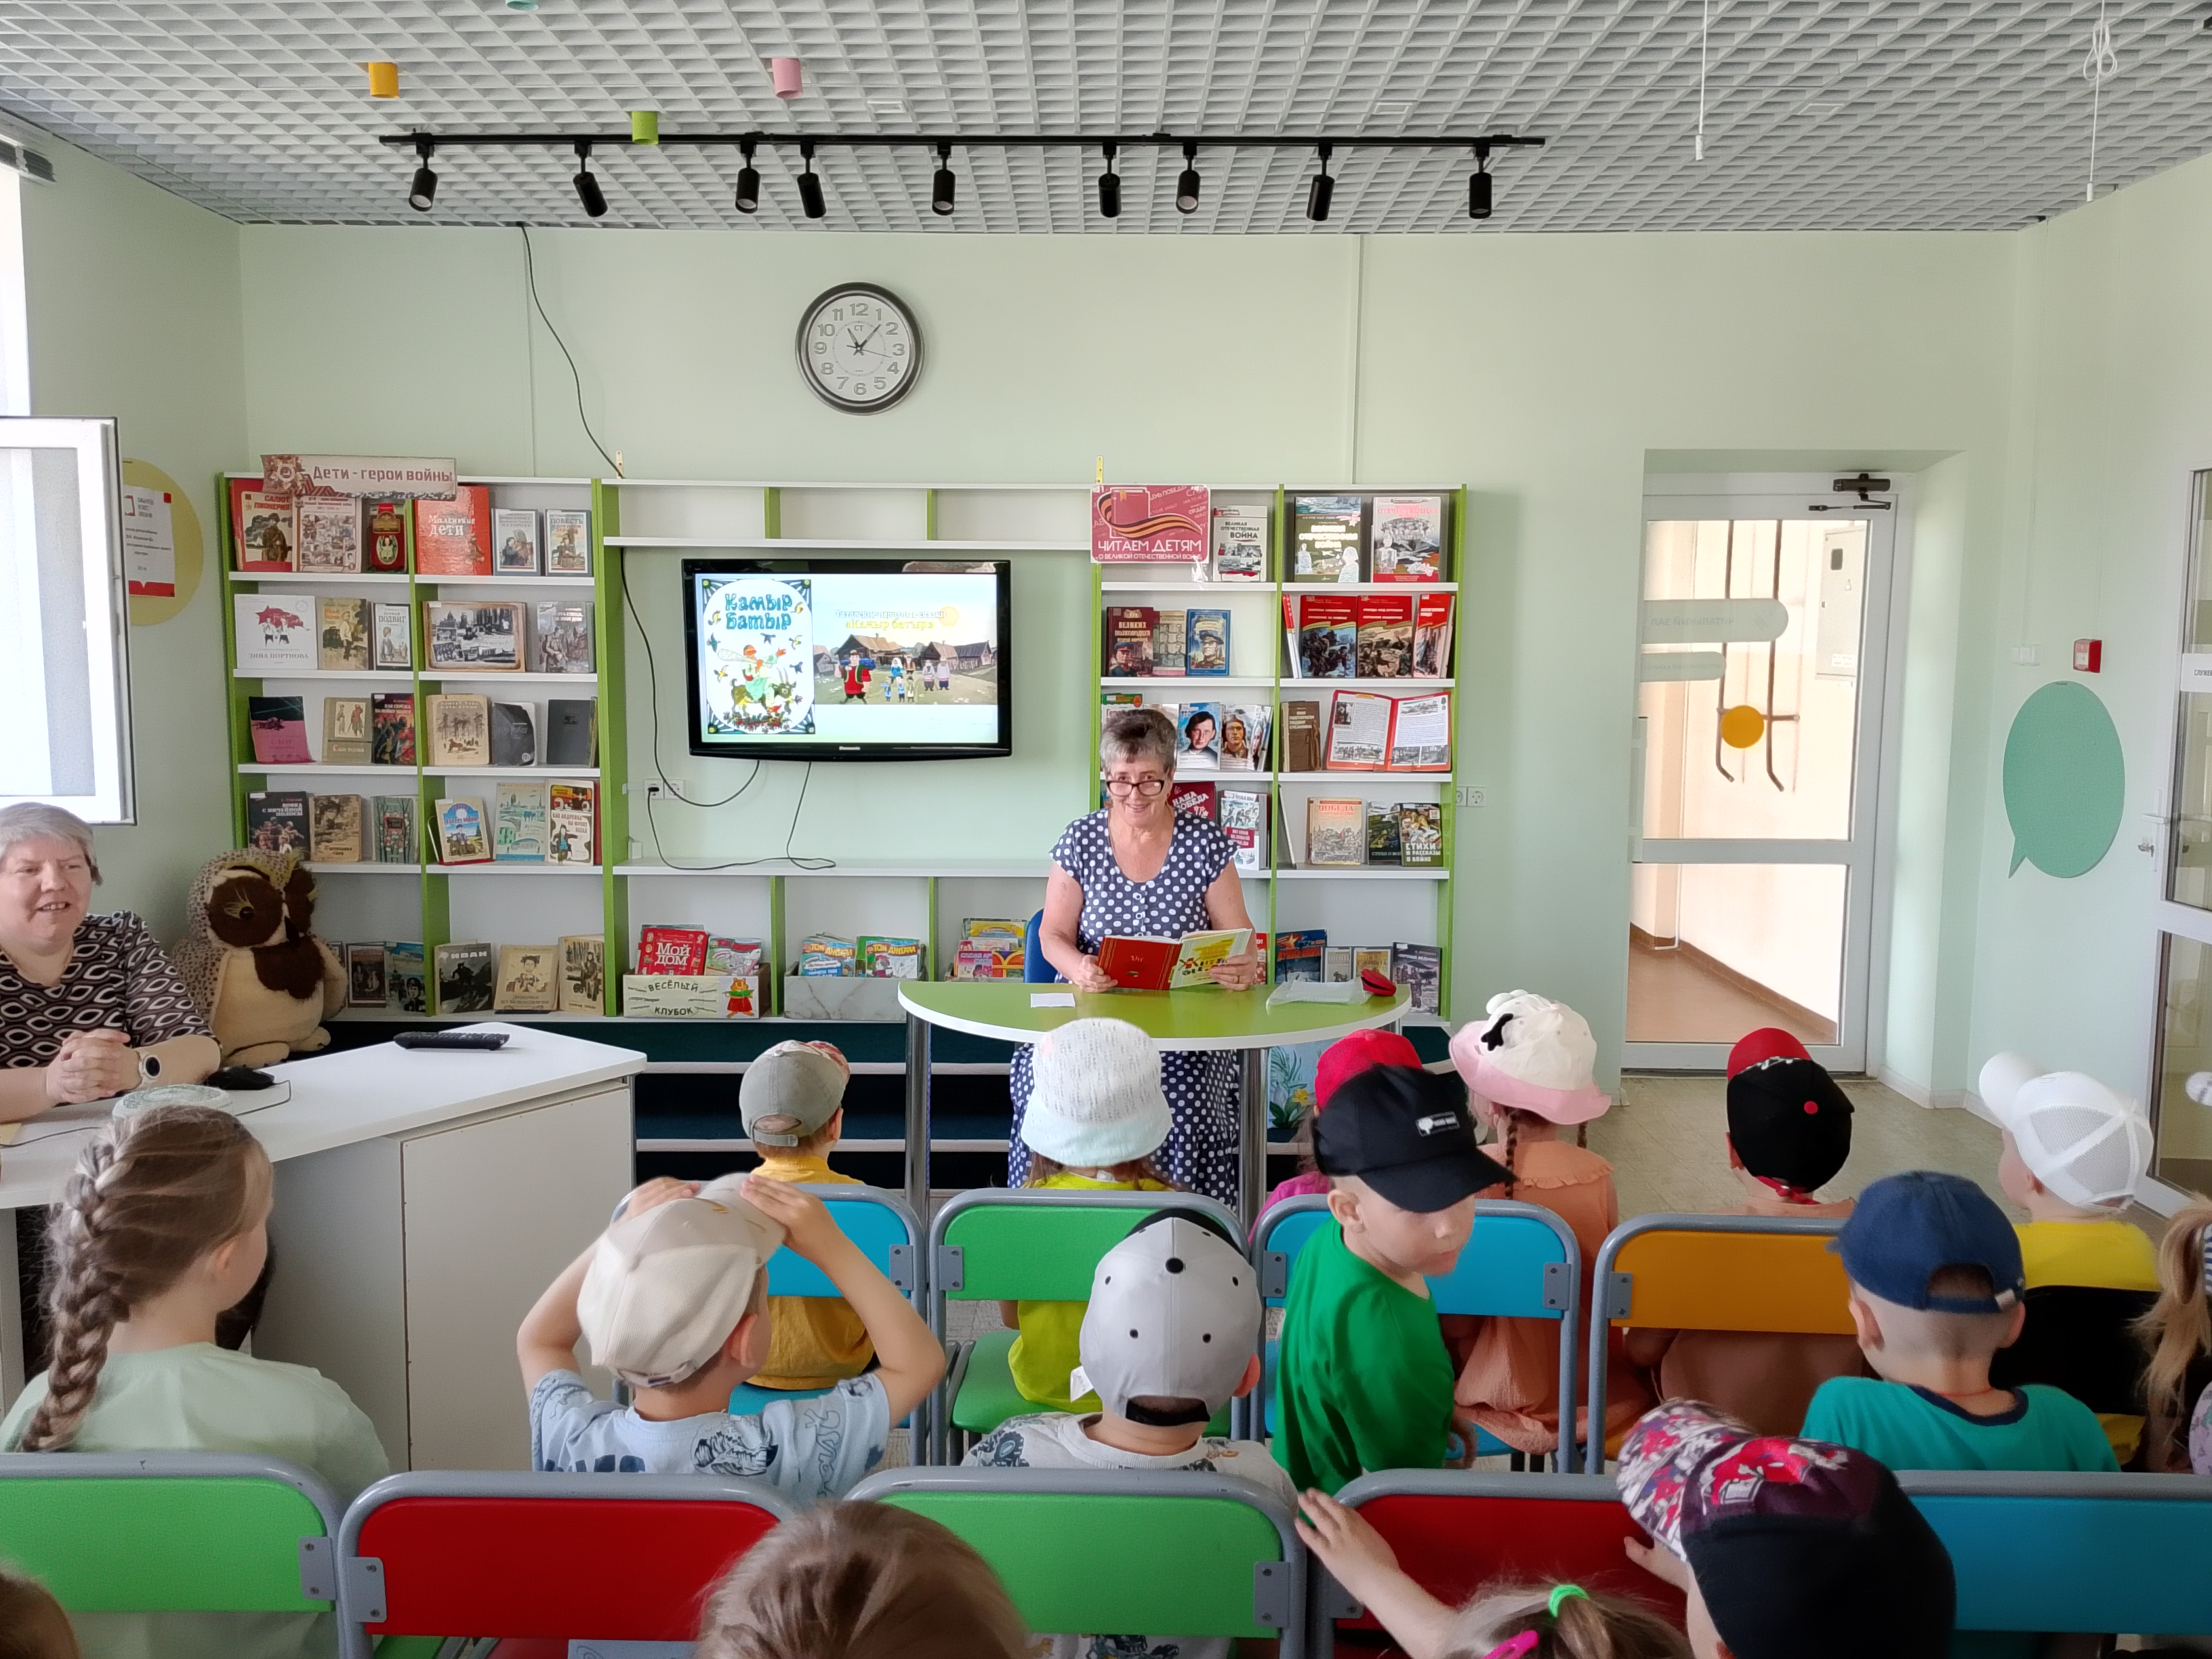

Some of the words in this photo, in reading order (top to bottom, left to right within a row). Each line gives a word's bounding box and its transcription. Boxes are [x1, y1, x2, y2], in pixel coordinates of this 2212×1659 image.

[832, 308, 844, 321] 11
[849, 302, 869, 316] 12
[876, 308, 882, 321] 1
[817, 323, 836, 337] 10
[885, 321, 899, 335] 2
[814, 342, 827, 355] 9
[892, 343, 905, 356] 3
[821, 362, 834, 375] 8
[886, 361, 900, 375] 4
[836, 376, 849, 390] 7
[853, 382, 867, 396] 6
[874, 376, 886, 390] 5
[314, 466, 349, 480] Дети
[361, 468, 403, 482] герои
[407, 468, 453, 482] войны
[1229, 531, 1258, 539] ВОЙНА
[1098, 540, 1149, 552] ЧИТАЕМ
[1151, 539, 1202, 553] ДЕТЯМ
[724, 593, 793, 611] Камыр
[378, 615, 407, 623] ПОДВИГ
[1172, 792, 1197, 807] НАША
[1405, 842, 1436, 851] СТИХИ
[451, 951, 487, 959] ИВАН
[655, 942, 691, 956] Мой
[648, 979, 699, 992] ВЕСЁЛЫЙ
[654, 1006, 693, 1017] КЛУБОК
